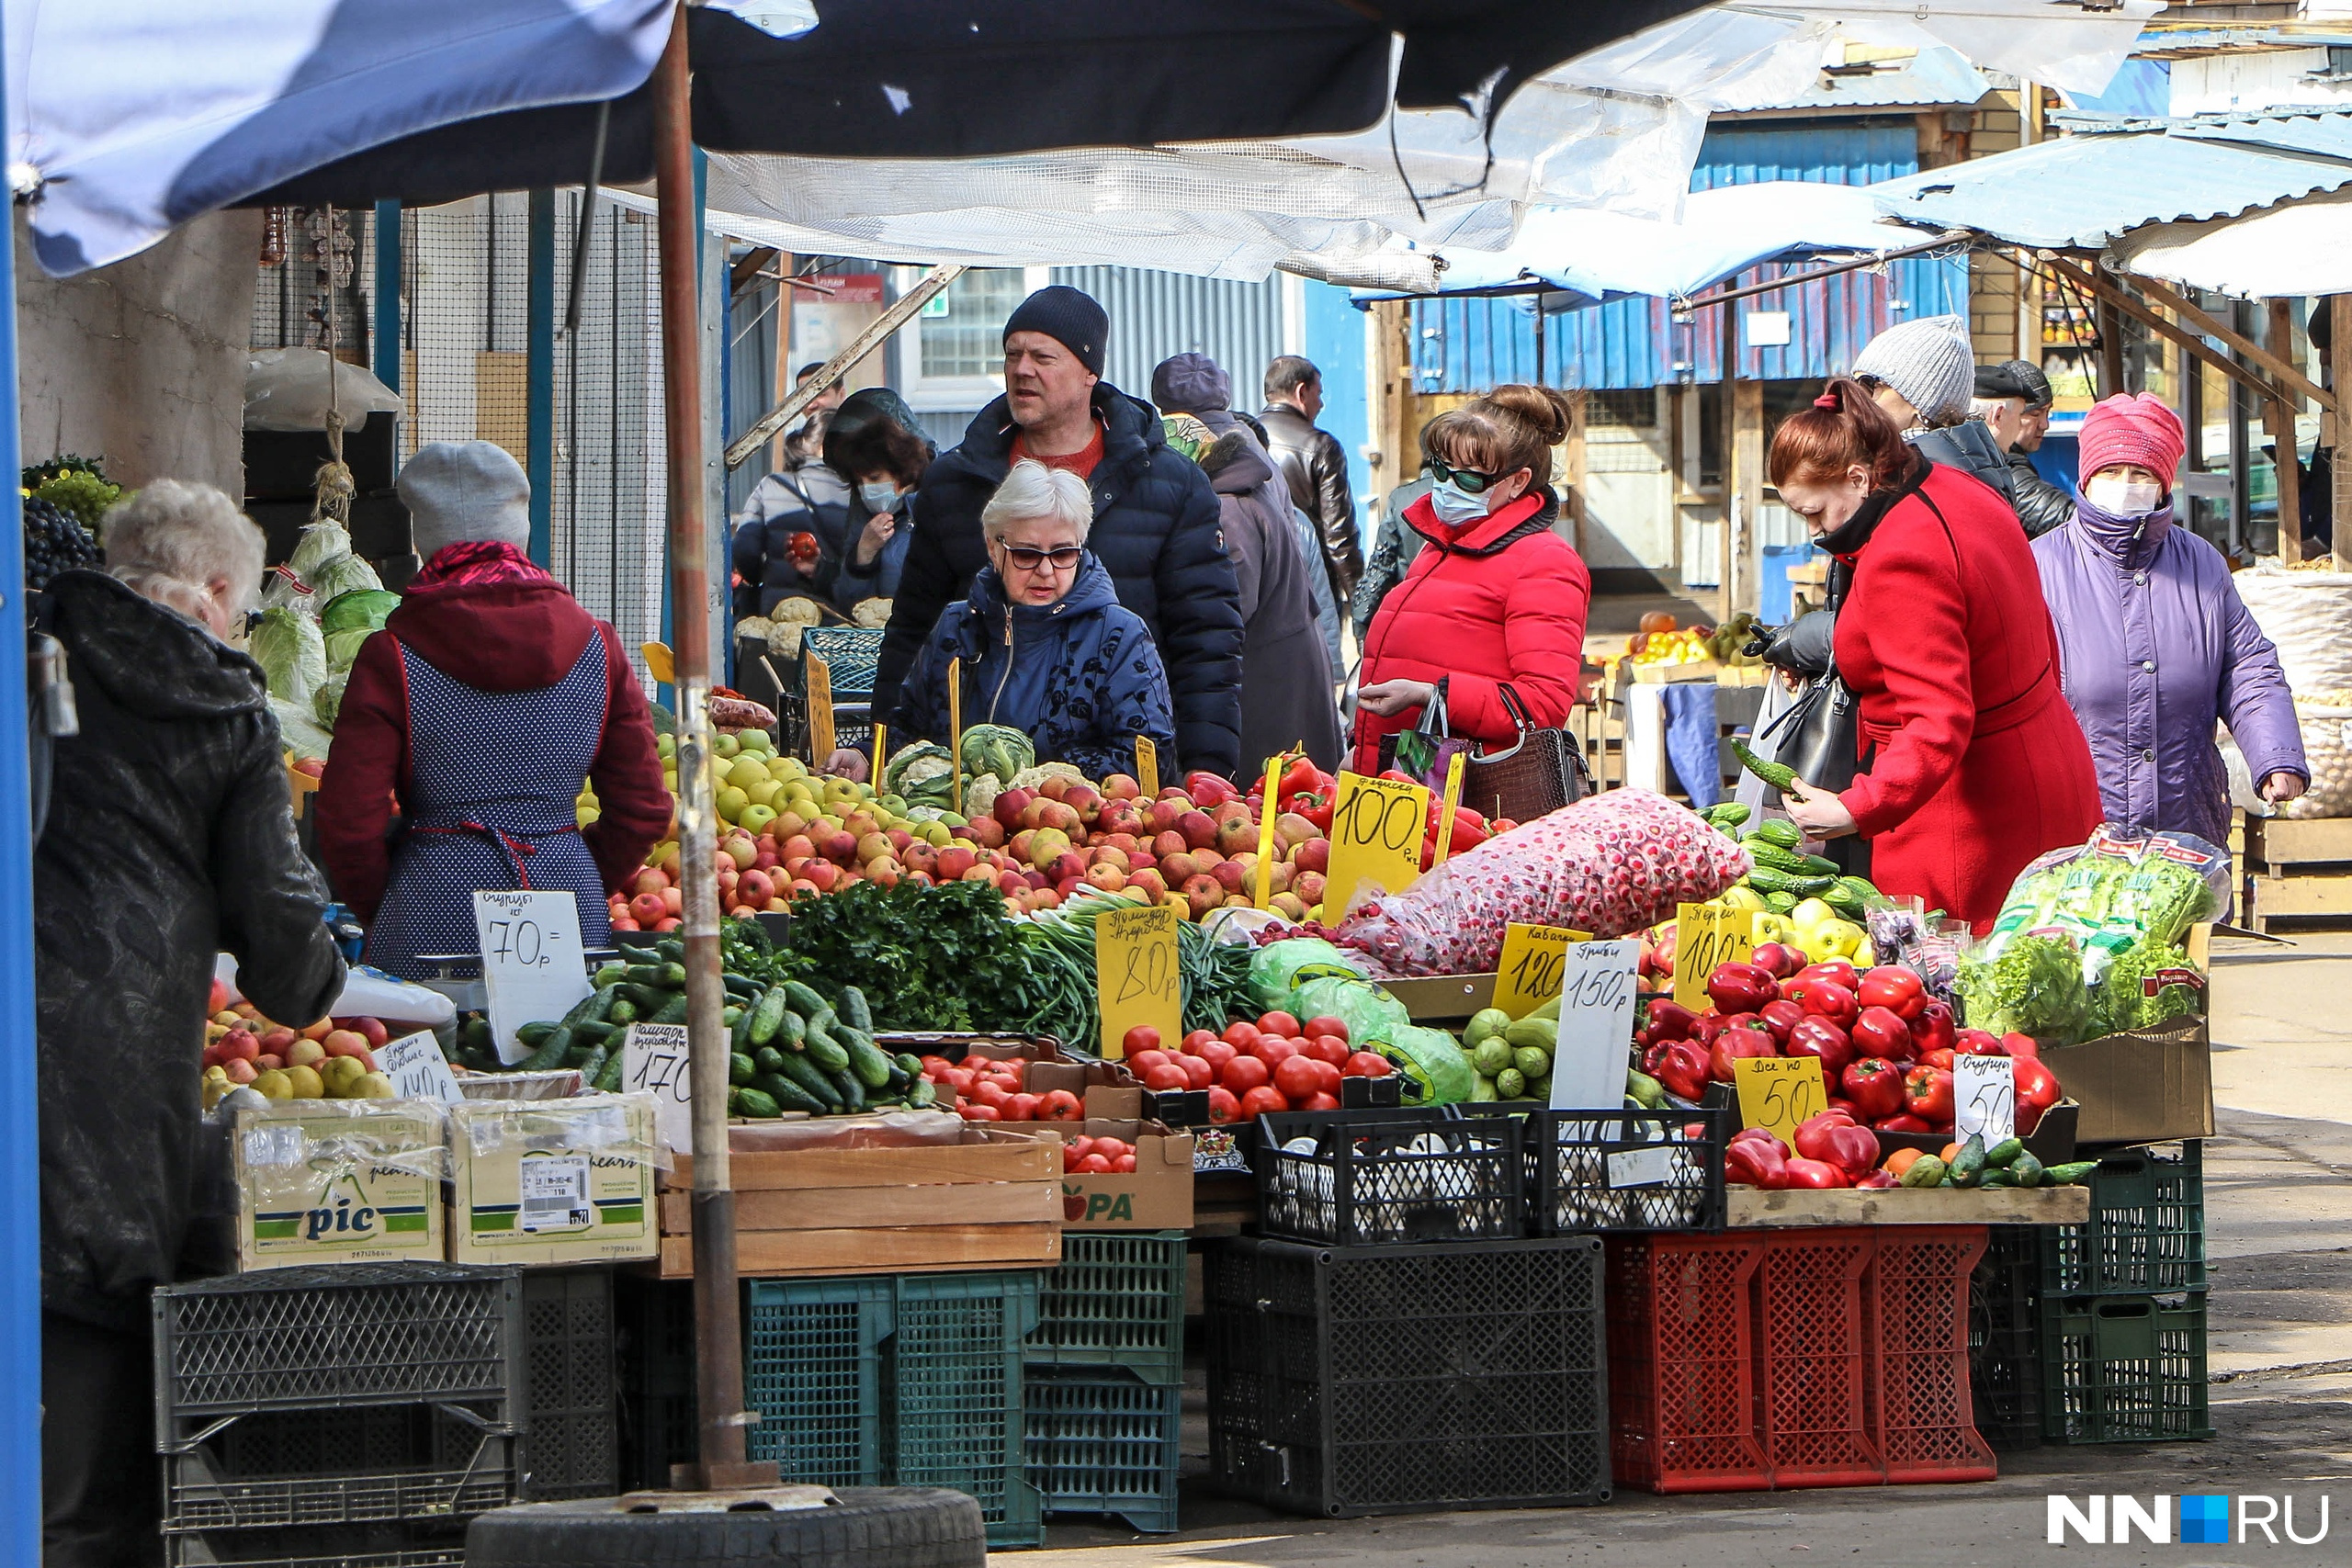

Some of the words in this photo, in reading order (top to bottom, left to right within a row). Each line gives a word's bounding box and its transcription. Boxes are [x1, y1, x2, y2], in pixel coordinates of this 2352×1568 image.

[1335, 786, 1418, 851] 100
[1510, 947, 1566, 999] 120
[1682, 930, 1735, 984] 100
[306, 1198, 375, 1240] pic
